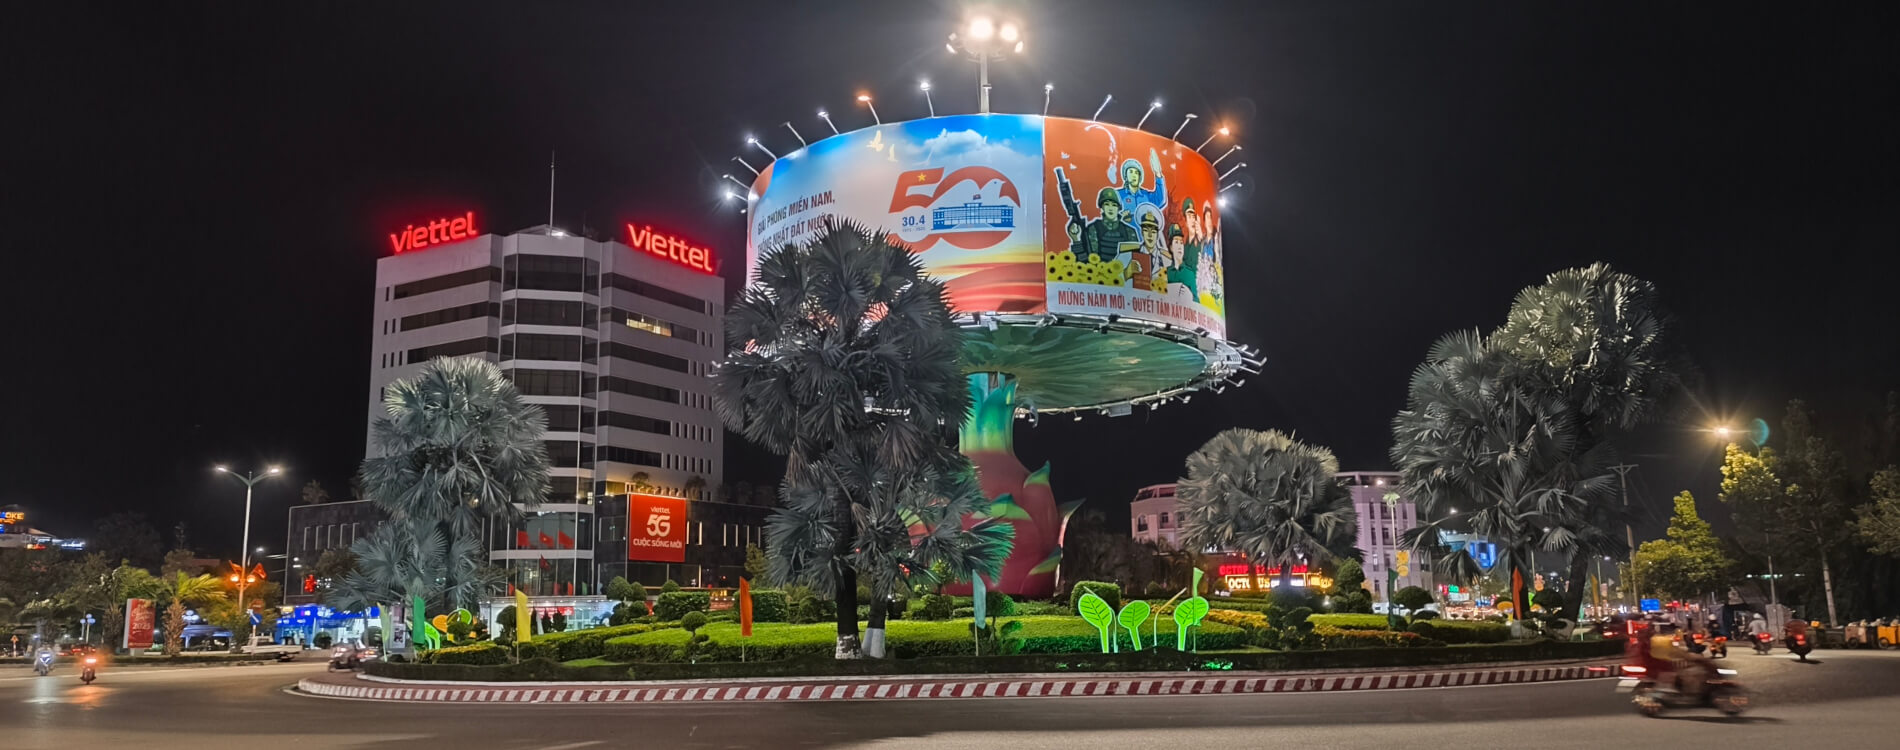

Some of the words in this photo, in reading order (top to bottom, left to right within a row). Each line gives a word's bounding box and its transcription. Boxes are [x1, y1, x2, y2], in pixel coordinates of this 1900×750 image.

[811, 190, 835, 209] NAM,
[889, 165, 1021, 253] 50
[791, 217, 806, 238] ĐẤT
[902, 214, 925, 227] 30.4
[390, 211, 477, 253] viettel
[627, 223, 713, 272] viettel
[1058, 287, 1085, 306] MỪNG
[1087, 290, 1108, 308] NĂM
[1109, 292, 1126, 310] MỚI
[1132, 294, 1154, 314] QUYẾT
[1156, 298, 1170, 317] TÂM
[650, 506, 671, 514] viettel
[646, 514, 671, 537] 5G
[633, 537, 651, 548] CUỘC
[651, 537, 670, 548] SỐNG
[670, 539, 682, 549] MỚI
